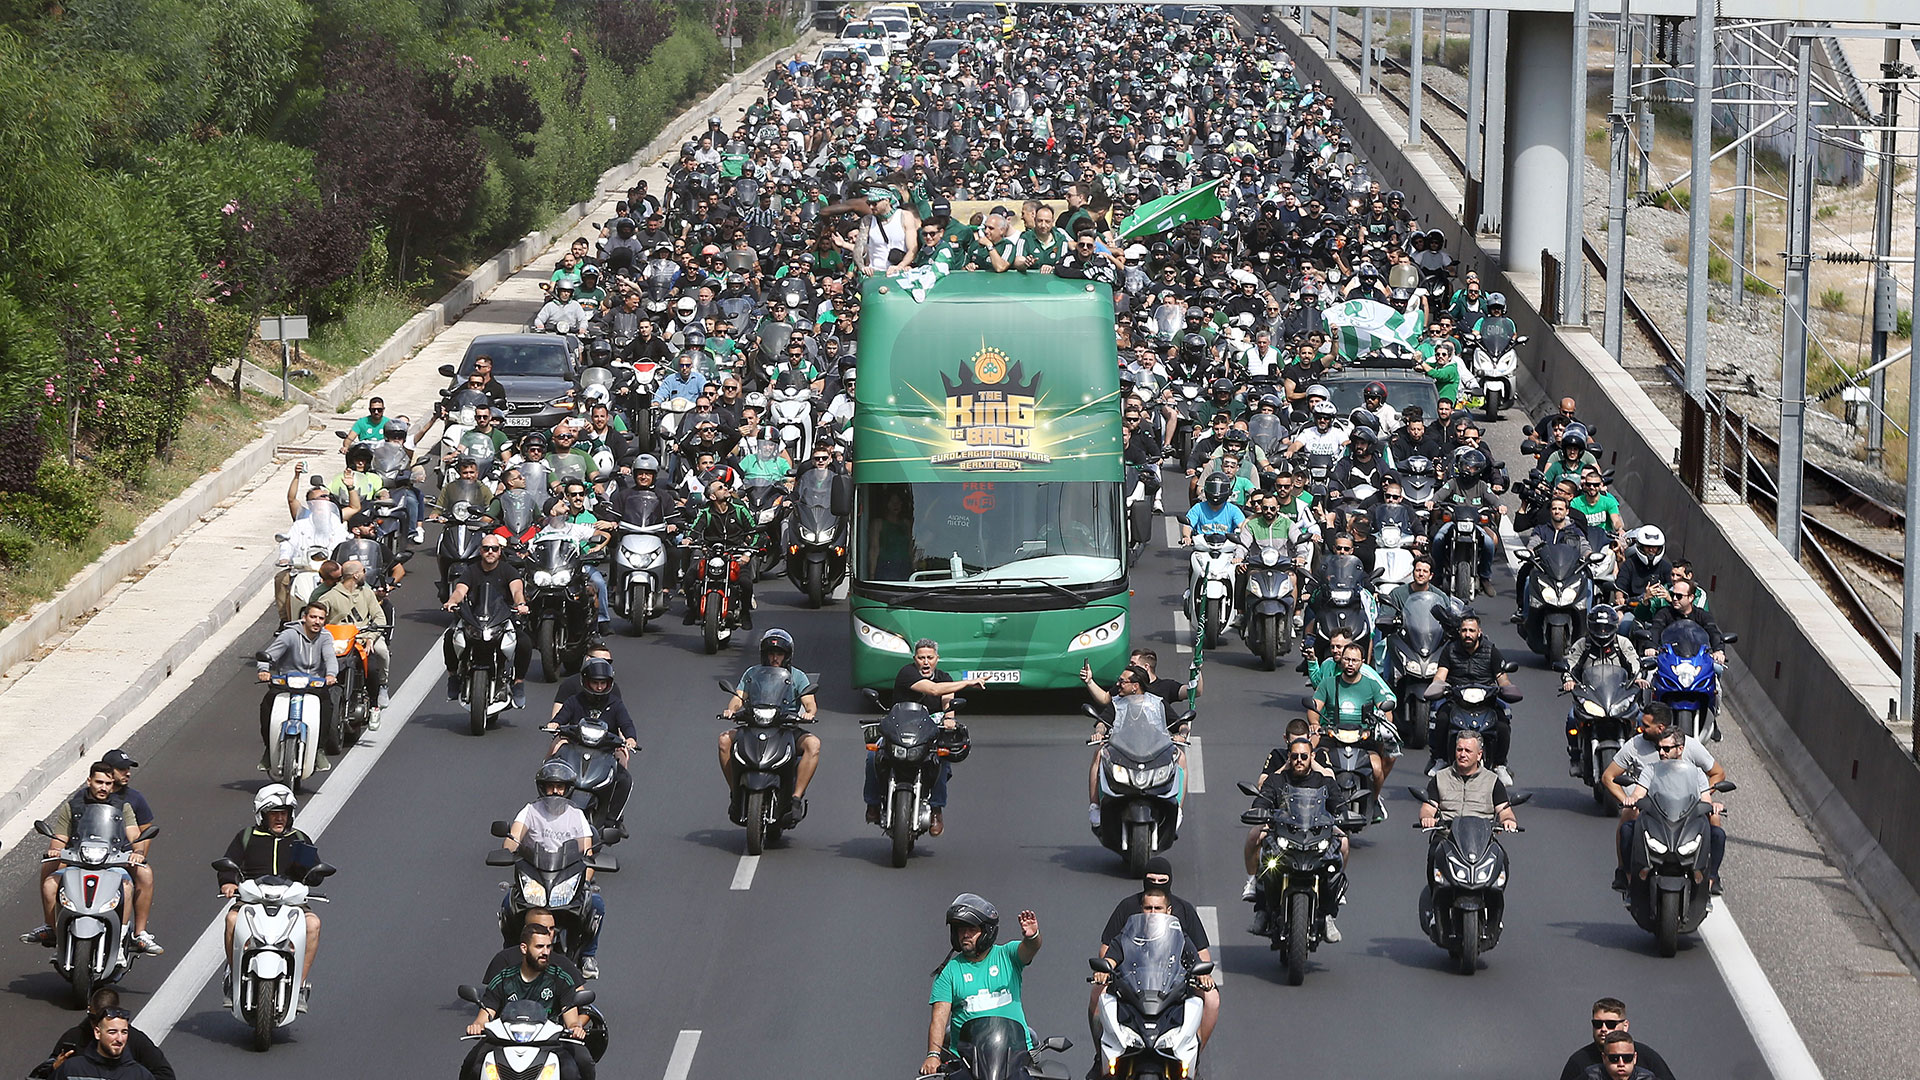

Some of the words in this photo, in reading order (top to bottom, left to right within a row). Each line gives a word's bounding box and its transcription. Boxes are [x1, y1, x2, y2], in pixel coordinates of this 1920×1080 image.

[977, 390, 1002, 401] THE
[951, 429, 966, 440] IS
[966, 428, 1029, 446] BACK
[930, 450, 993, 464] EUROLEAGUE
[993, 450, 1051, 463] CHAMPIONS
[960, 460, 993, 470] BERLIN
[995, 460, 1021, 470] 2024
[962, 482, 996, 491] FREE
[993, 671, 1020, 682] 5915
